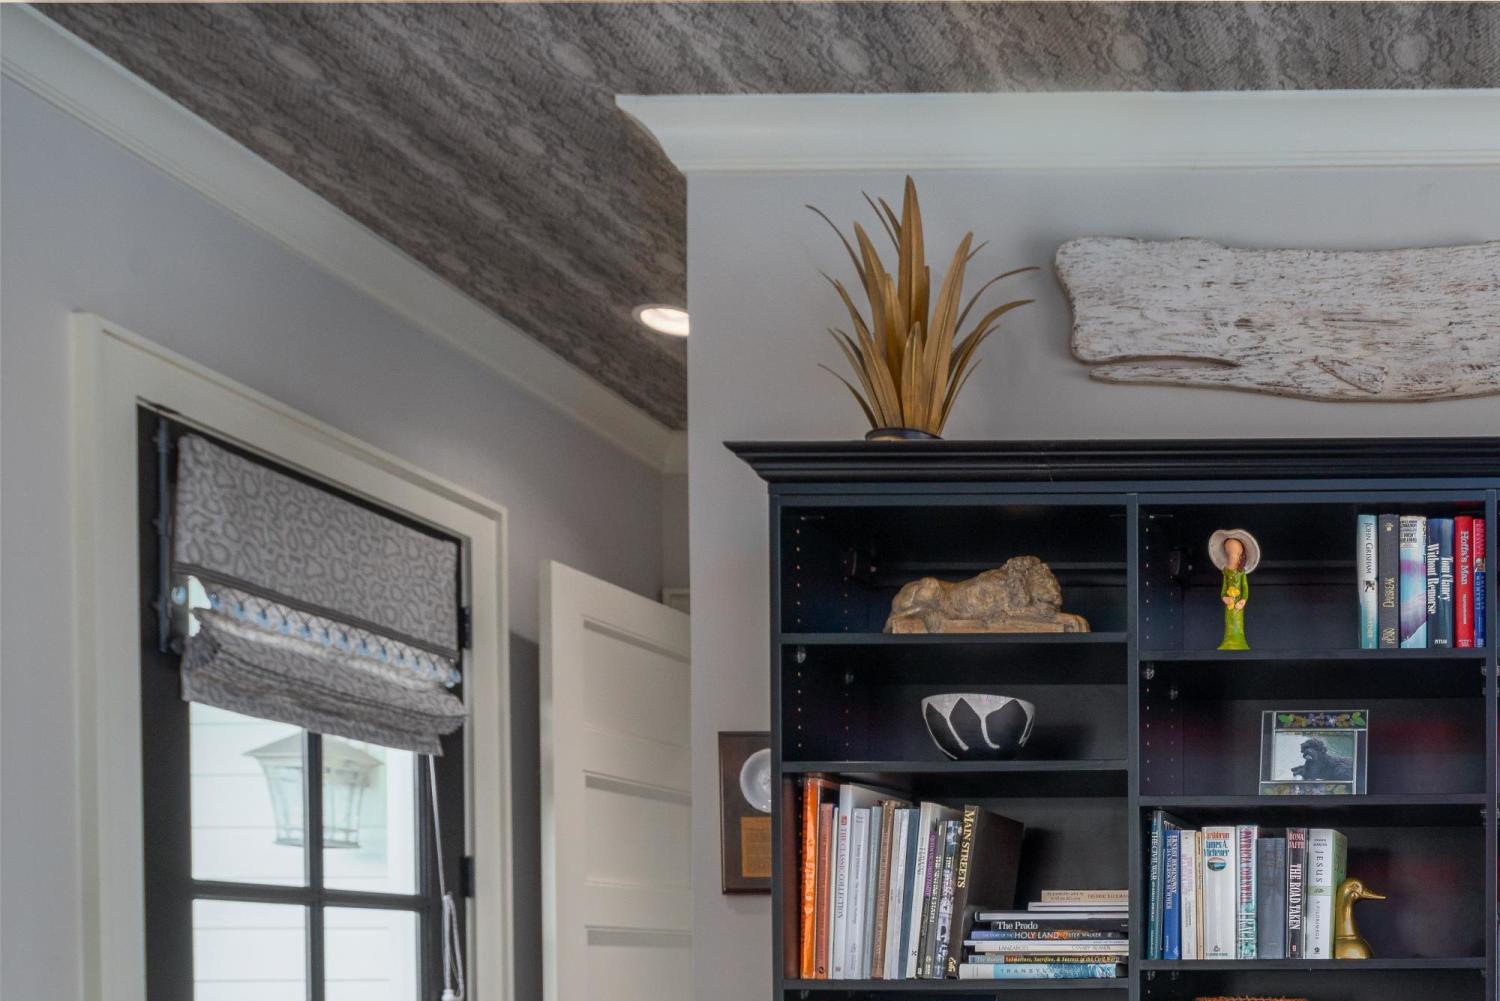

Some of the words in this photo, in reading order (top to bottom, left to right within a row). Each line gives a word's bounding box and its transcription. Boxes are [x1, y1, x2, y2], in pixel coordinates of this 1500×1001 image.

[1427, 544, 1439, 576] Without
[1460, 531, 1469, 562] Hoffa's
[1441, 557, 1453, 573] Tom
[1427, 578, 1439, 614] Remorse
[1438, 574, 1453, 602] Clancy
[962, 808, 975, 840] MAIN
[838, 842, 846, 873] CLASSIC
[957, 841, 971, 888] STREETS
[1289, 864, 1301, 880] THE
[1315, 850, 1324, 883] JESUS
[837, 873, 845, 919] COLLECTION
[1289, 882, 1301, 904] ROAD
[997, 921, 1013, 929] The
[1015, 921, 1038, 929] Prado
[1289, 905, 1300, 930] TAKEN
[1015, 931, 1036, 939] HOLY
[1037, 931, 1059, 939] LAND
